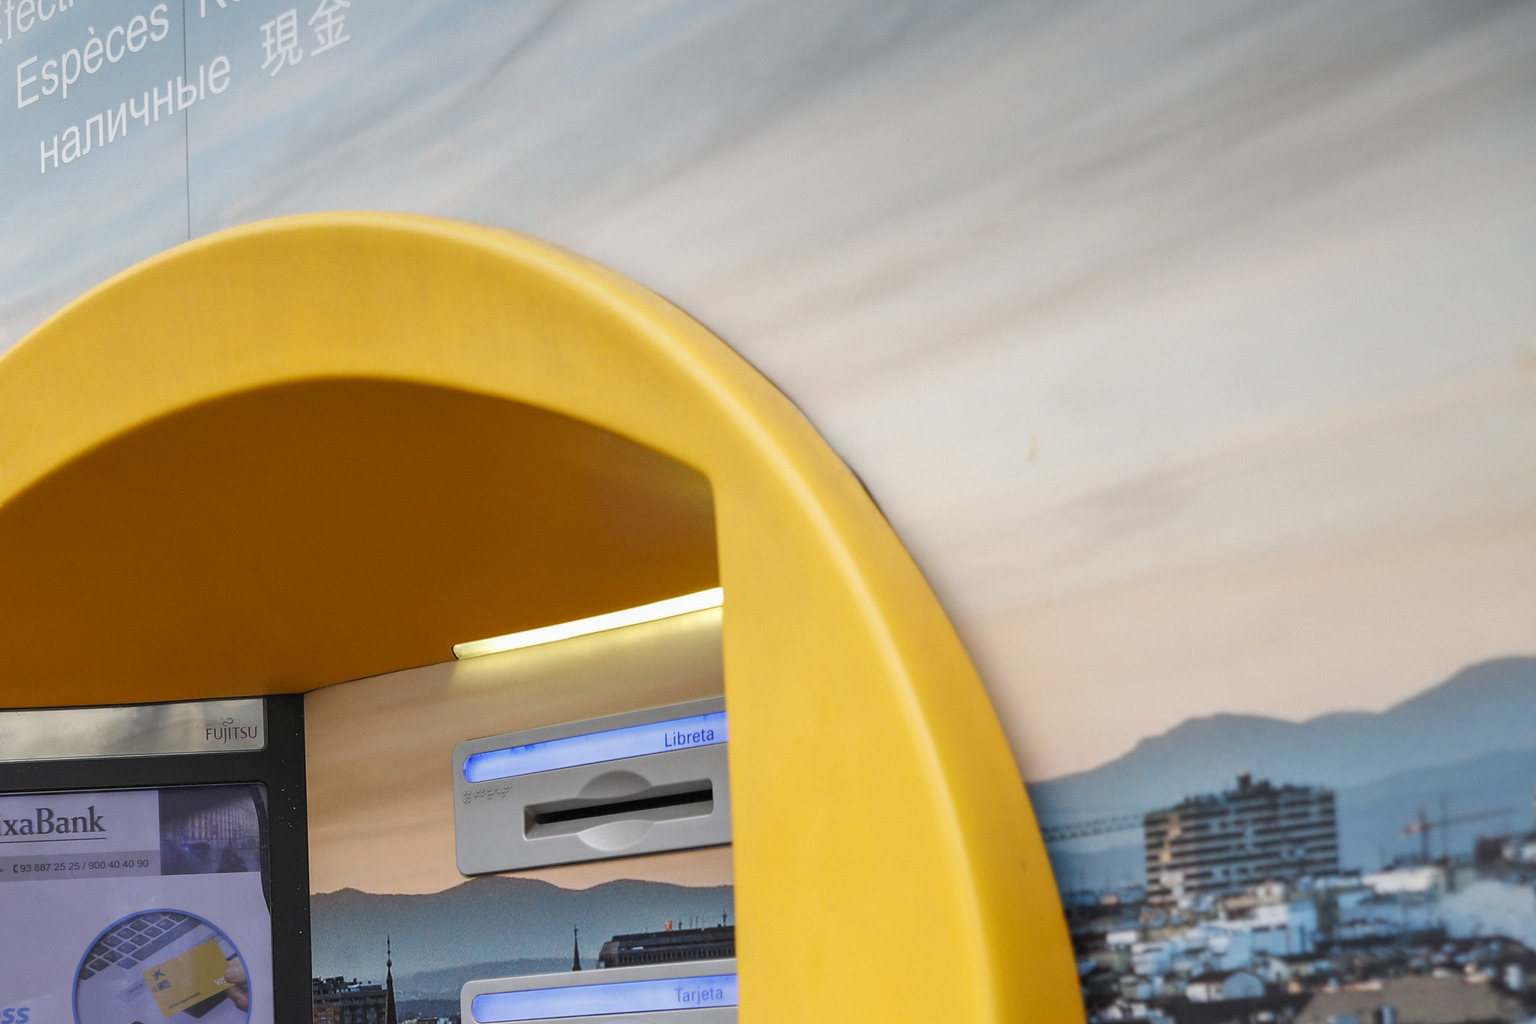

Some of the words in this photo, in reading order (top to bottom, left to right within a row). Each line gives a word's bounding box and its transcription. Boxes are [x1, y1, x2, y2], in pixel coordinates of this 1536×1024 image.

[260, 0, 352, 78] 現金
[16, 2, 170, 109] Espèces
[39, 55, 231, 174] наличные
[205, 718, 258, 744] FUJITSU
[664, 728, 714, 748] Libreta
[19, 864, 32, 873] 93
[33, 863, 51, 872] 887
[54, 862, 65, 871] 25
[68, 862, 80, 871] 25
[87, 861, 106, 870] 900
[108, 860, 120, 869] 40
[122, 860, 135, 869] 40
[137, 859, 149, 868] 90
[674, 986, 723, 1005] Tarjeta
